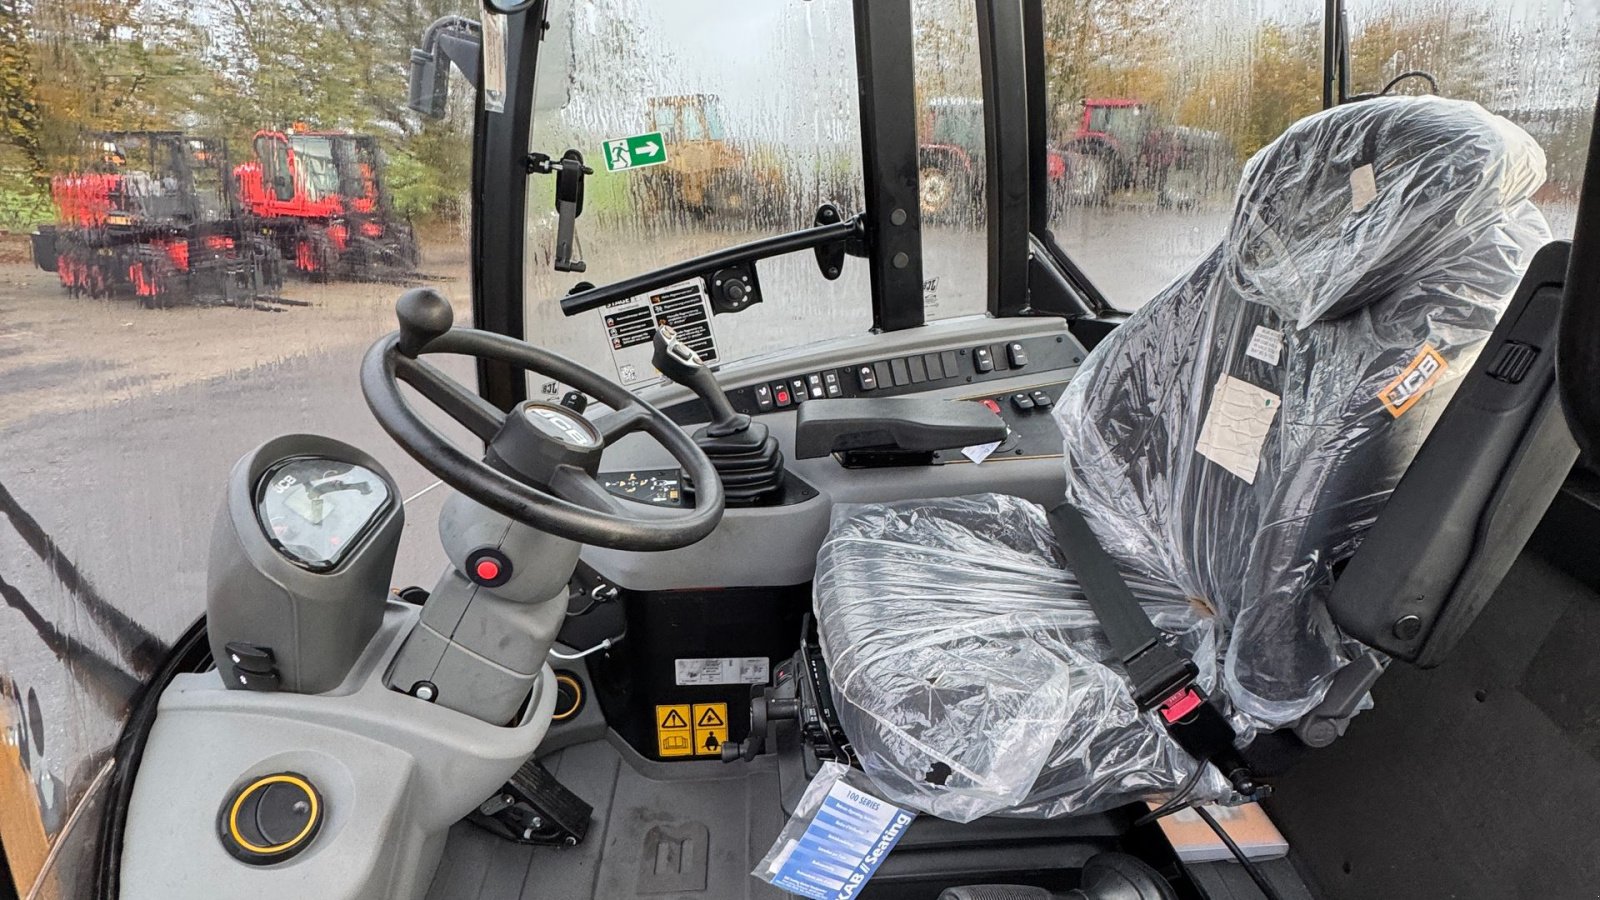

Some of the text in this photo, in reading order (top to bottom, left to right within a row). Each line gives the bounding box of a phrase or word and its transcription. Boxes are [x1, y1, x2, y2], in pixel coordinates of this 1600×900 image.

[1388, 353, 1440, 408] JCB
[531, 410, 588, 446] JCB
[274, 475, 296, 493] JCB
[847, 790, 881, 812] 100 SERIES
[865, 813, 912, 865] Seating
